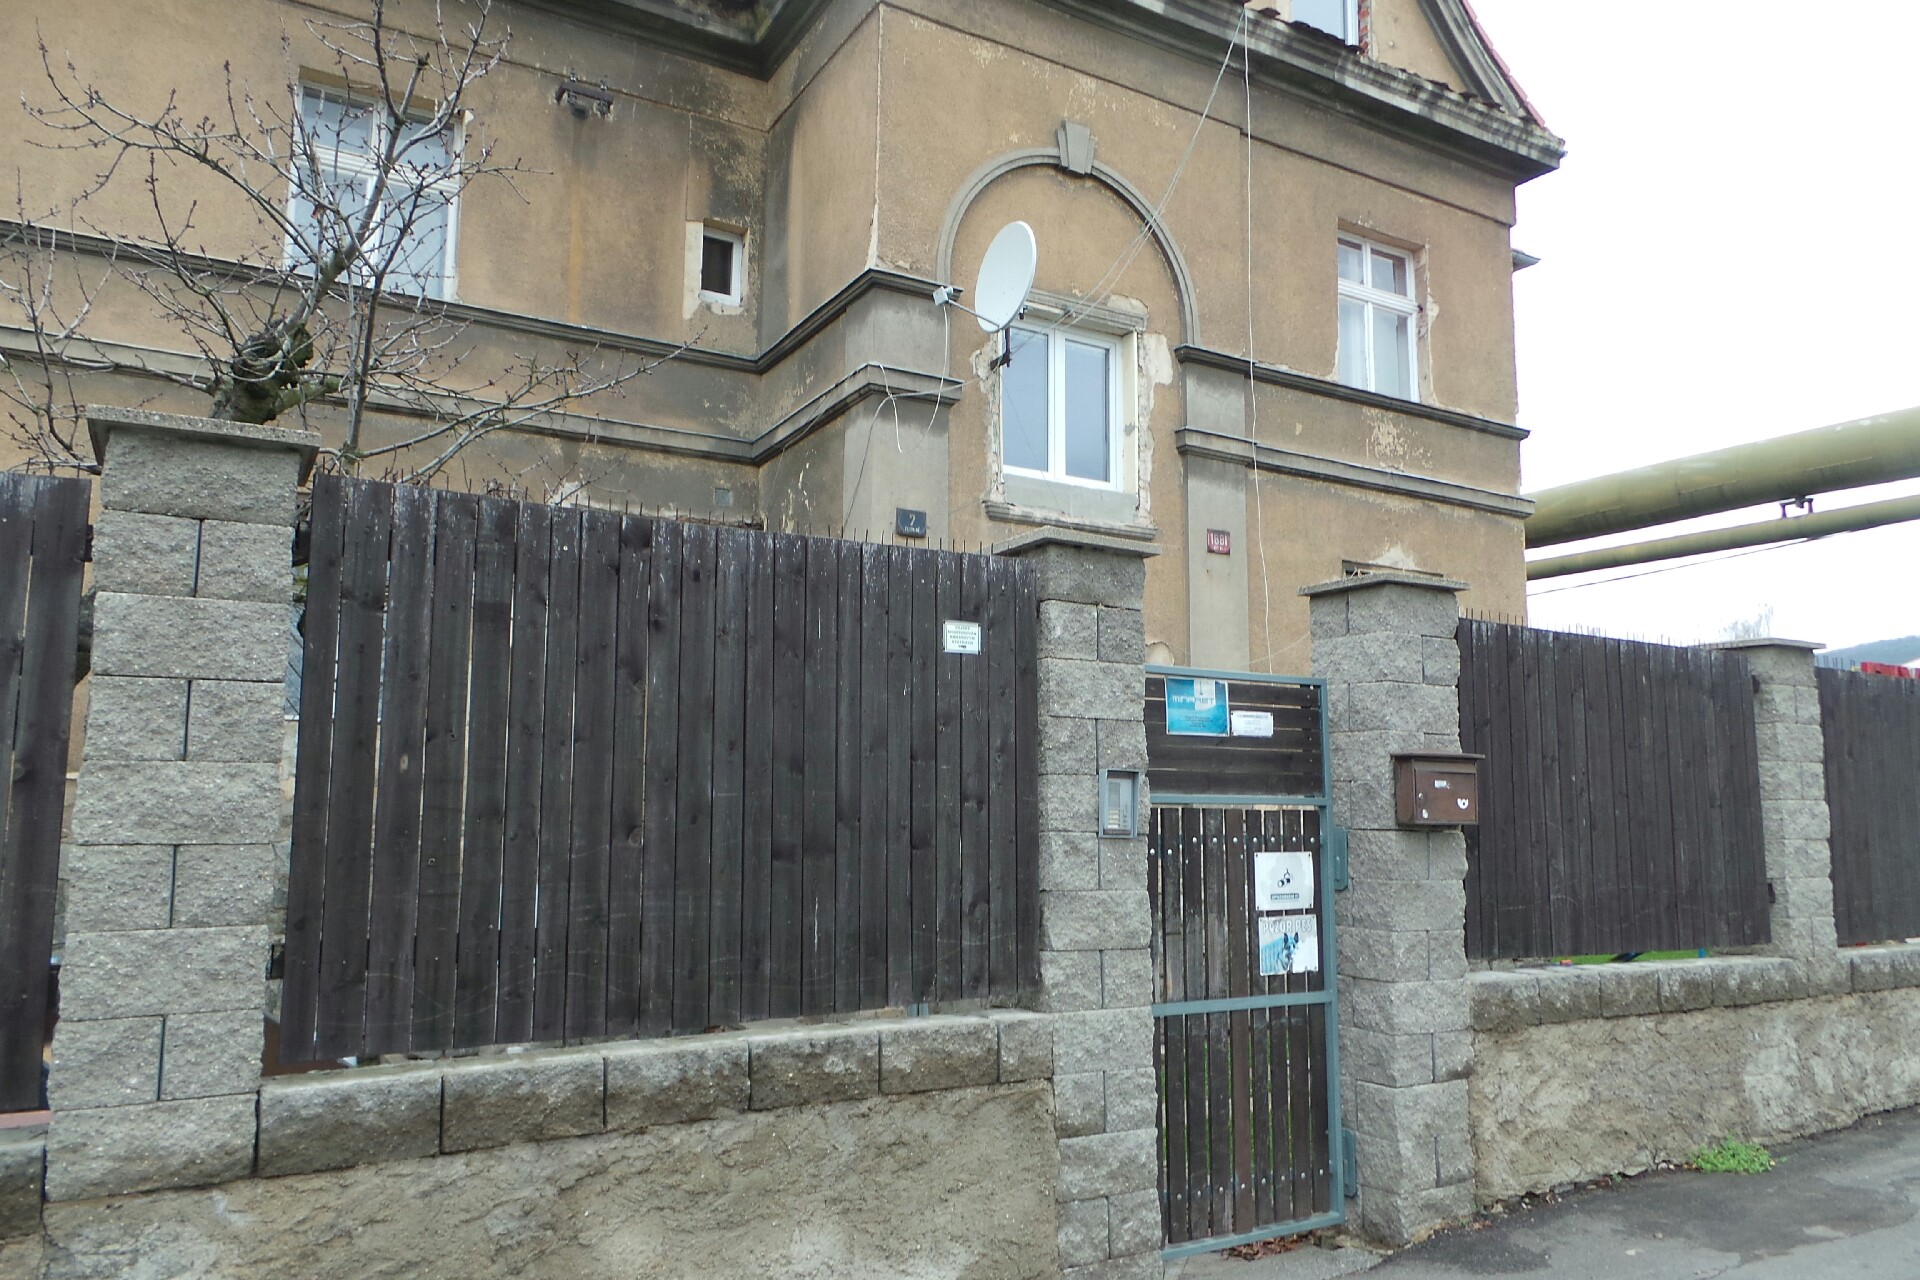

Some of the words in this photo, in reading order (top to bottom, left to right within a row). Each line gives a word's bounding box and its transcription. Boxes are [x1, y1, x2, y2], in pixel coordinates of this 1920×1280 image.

[1210, 532, 1228, 546] 1881
[1262, 919, 1292, 934] POZOR
[1295, 918, 1313, 932] PES
